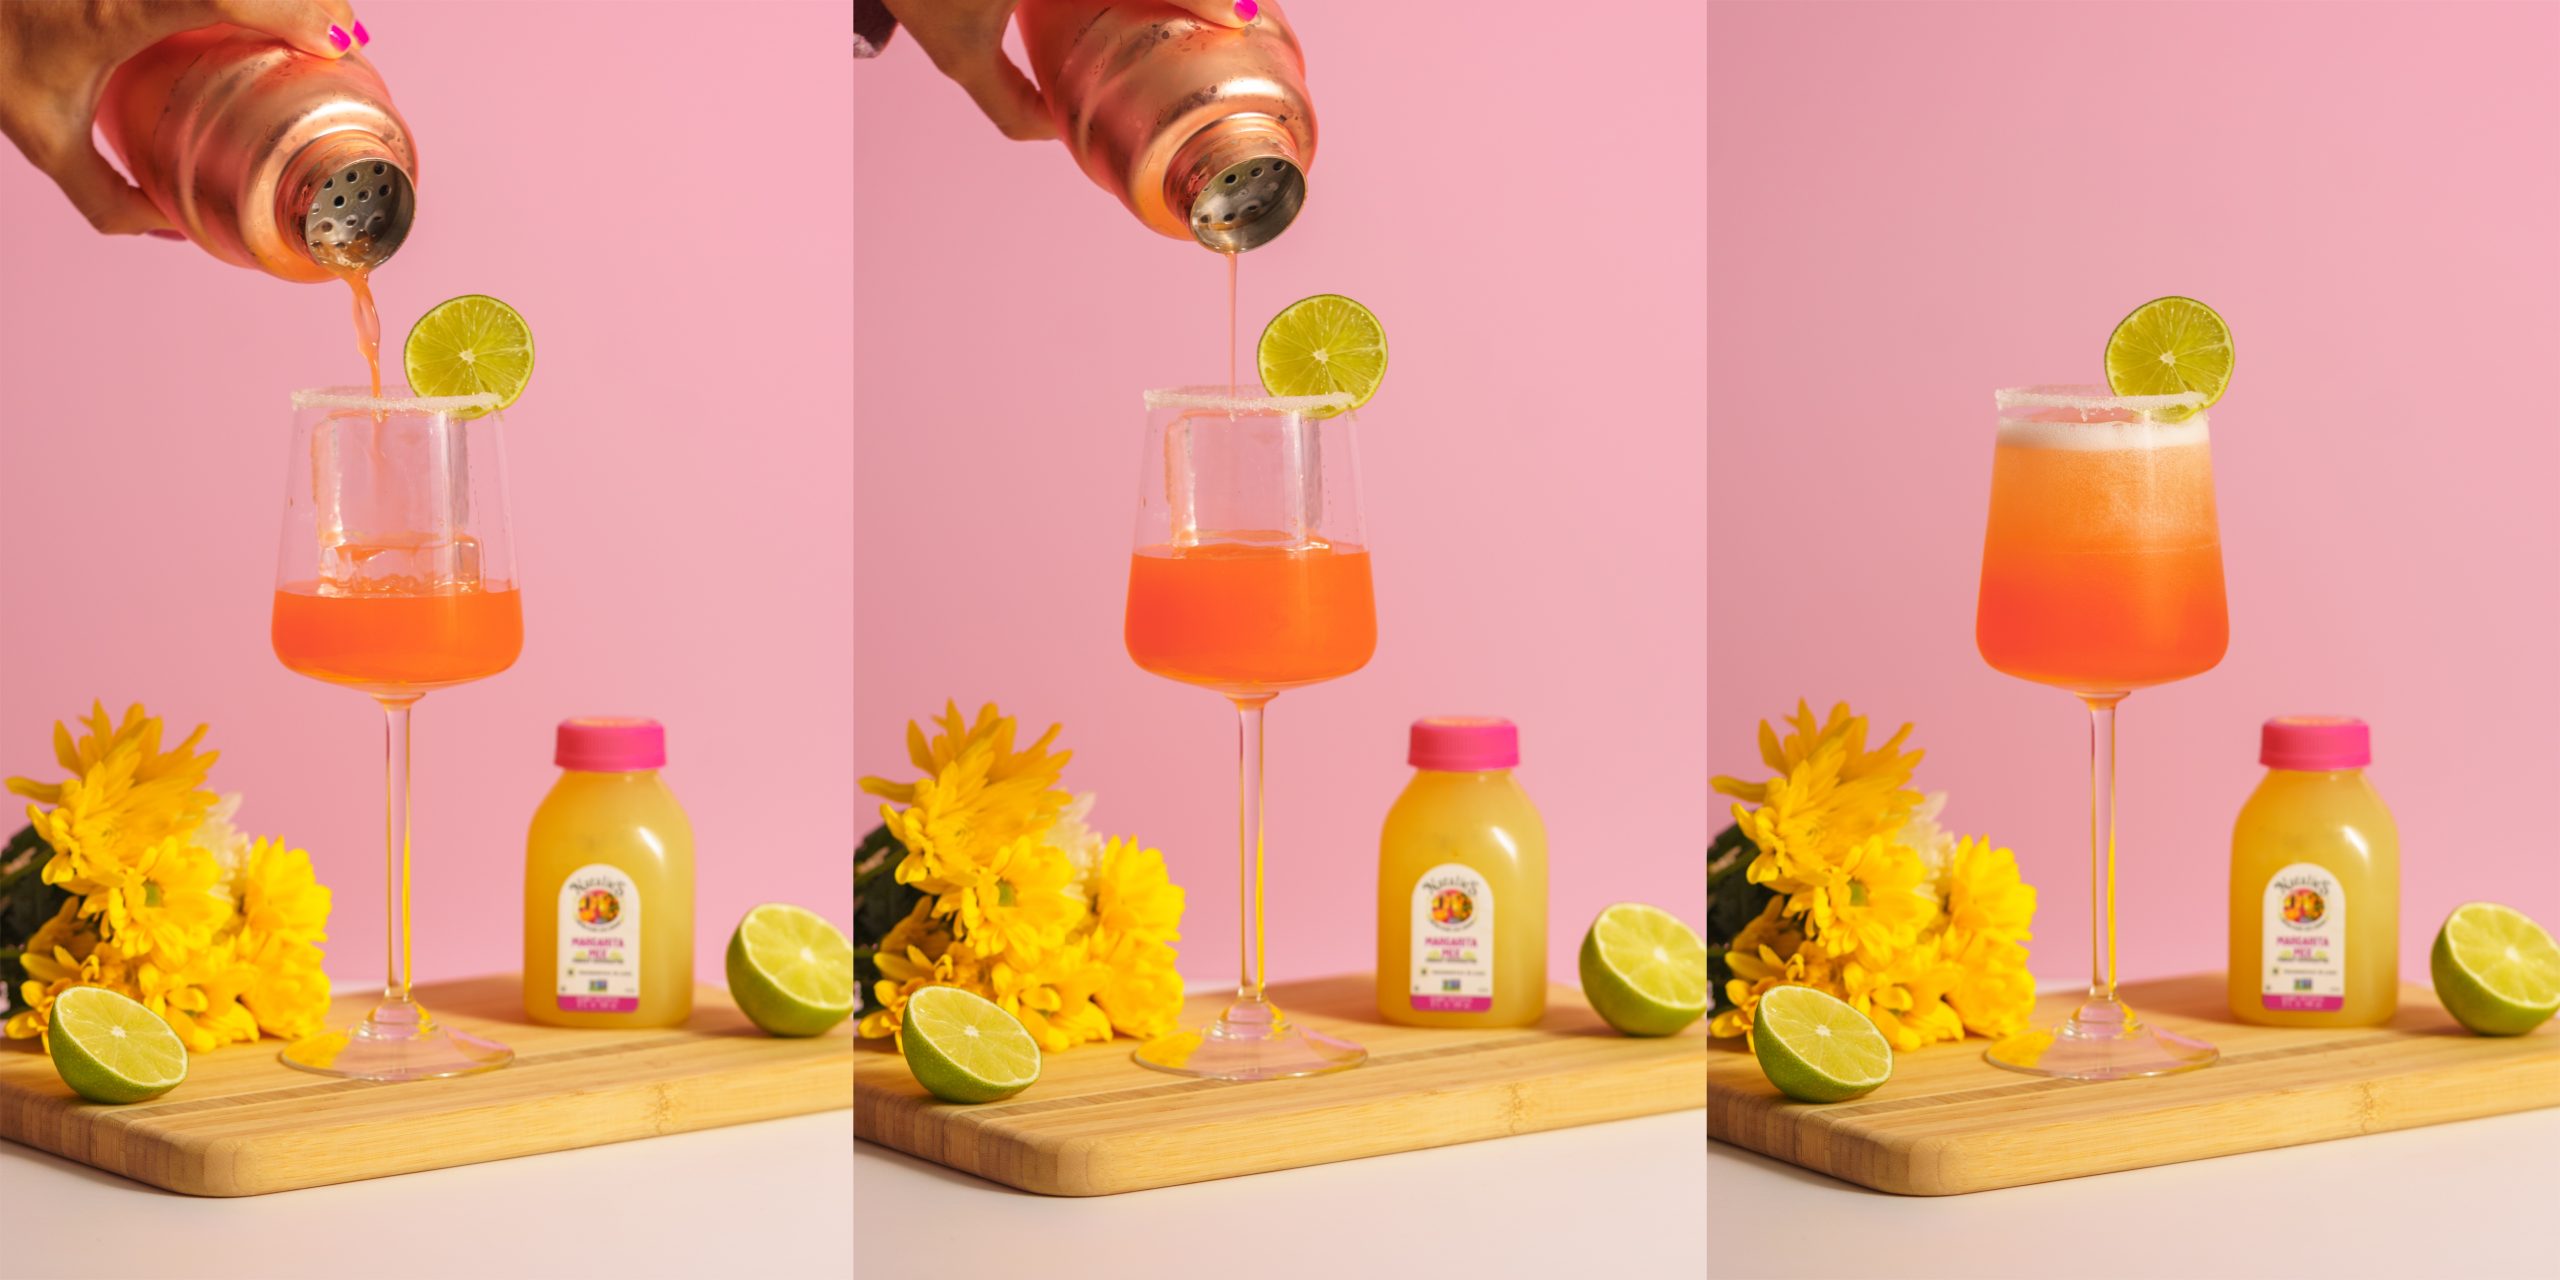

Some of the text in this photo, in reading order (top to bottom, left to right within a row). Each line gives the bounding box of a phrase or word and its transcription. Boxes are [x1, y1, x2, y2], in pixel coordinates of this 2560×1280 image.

[571, 937, 624, 947] MARGARITA
[1424, 937, 1477, 947] MARGARITA
[2276, 936, 2329, 946] MARGARITA
